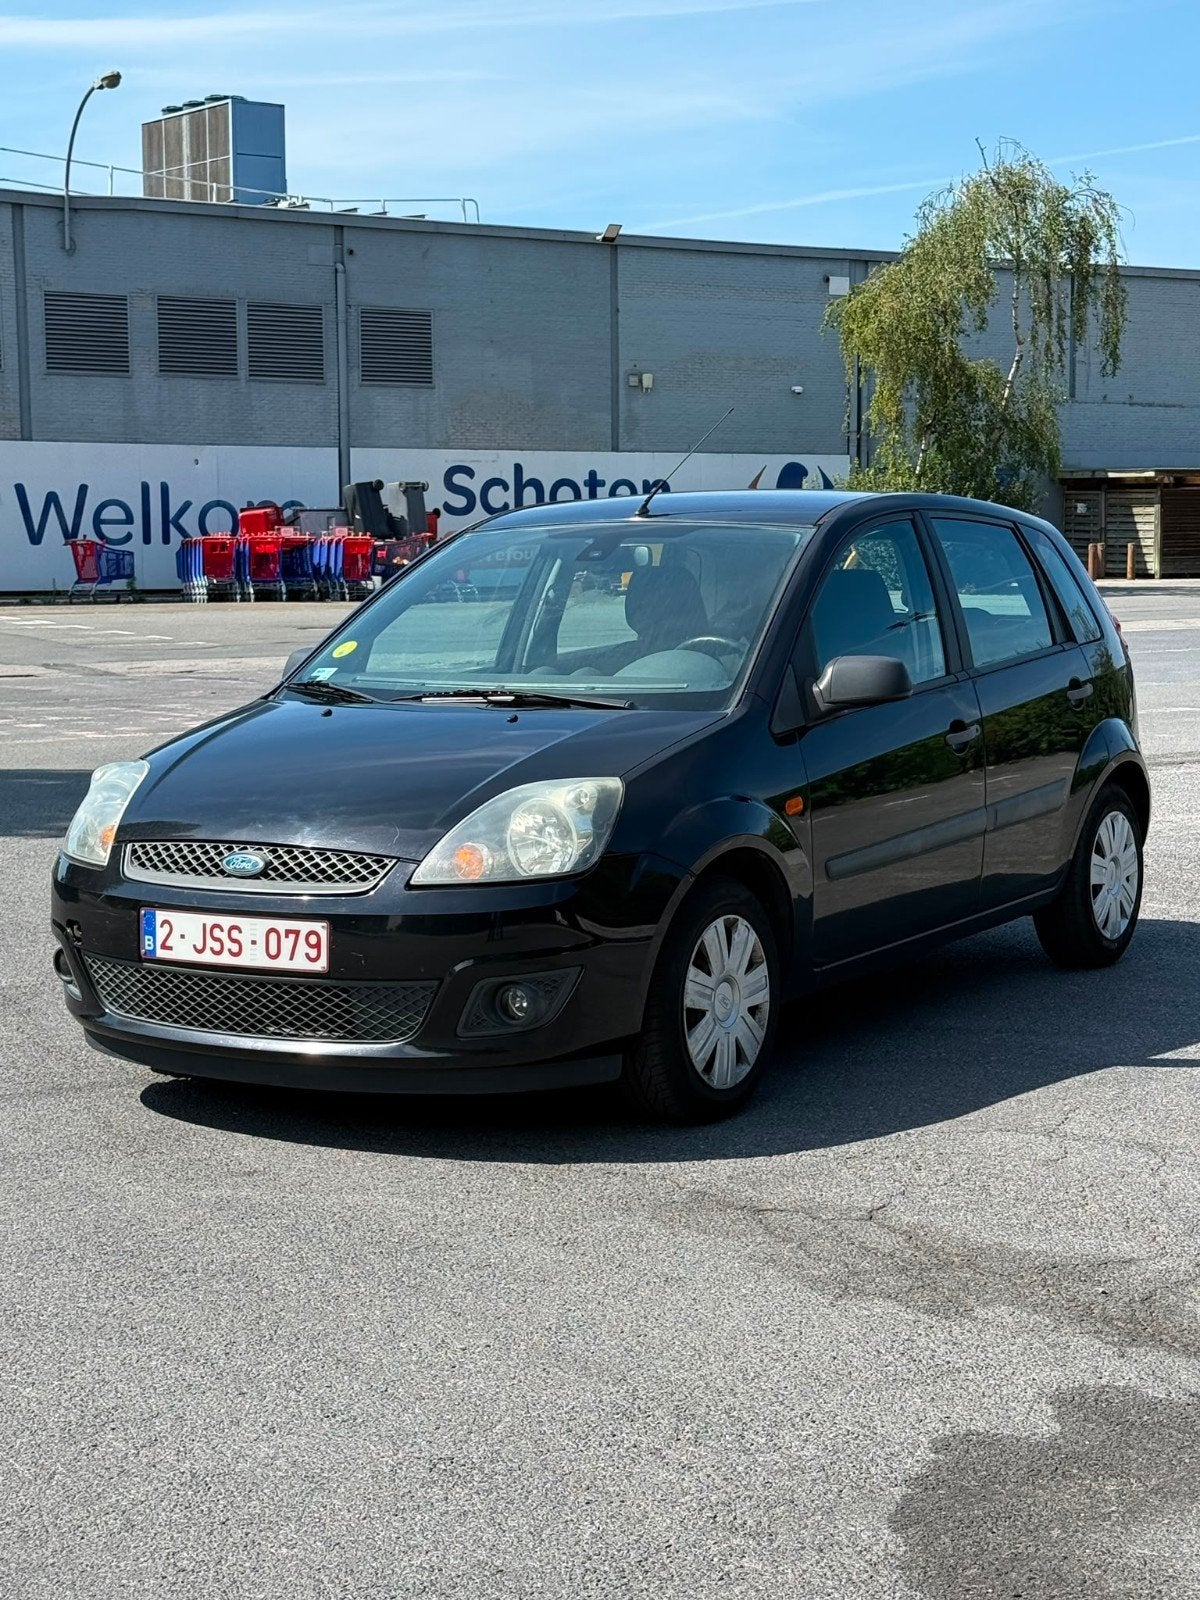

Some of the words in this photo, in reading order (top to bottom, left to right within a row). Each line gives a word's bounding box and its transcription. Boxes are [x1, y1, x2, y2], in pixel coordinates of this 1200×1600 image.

[14, 481, 304, 546] Welko
[226, 855, 259, 869] Ford
[144, 935, 154, 950] B
